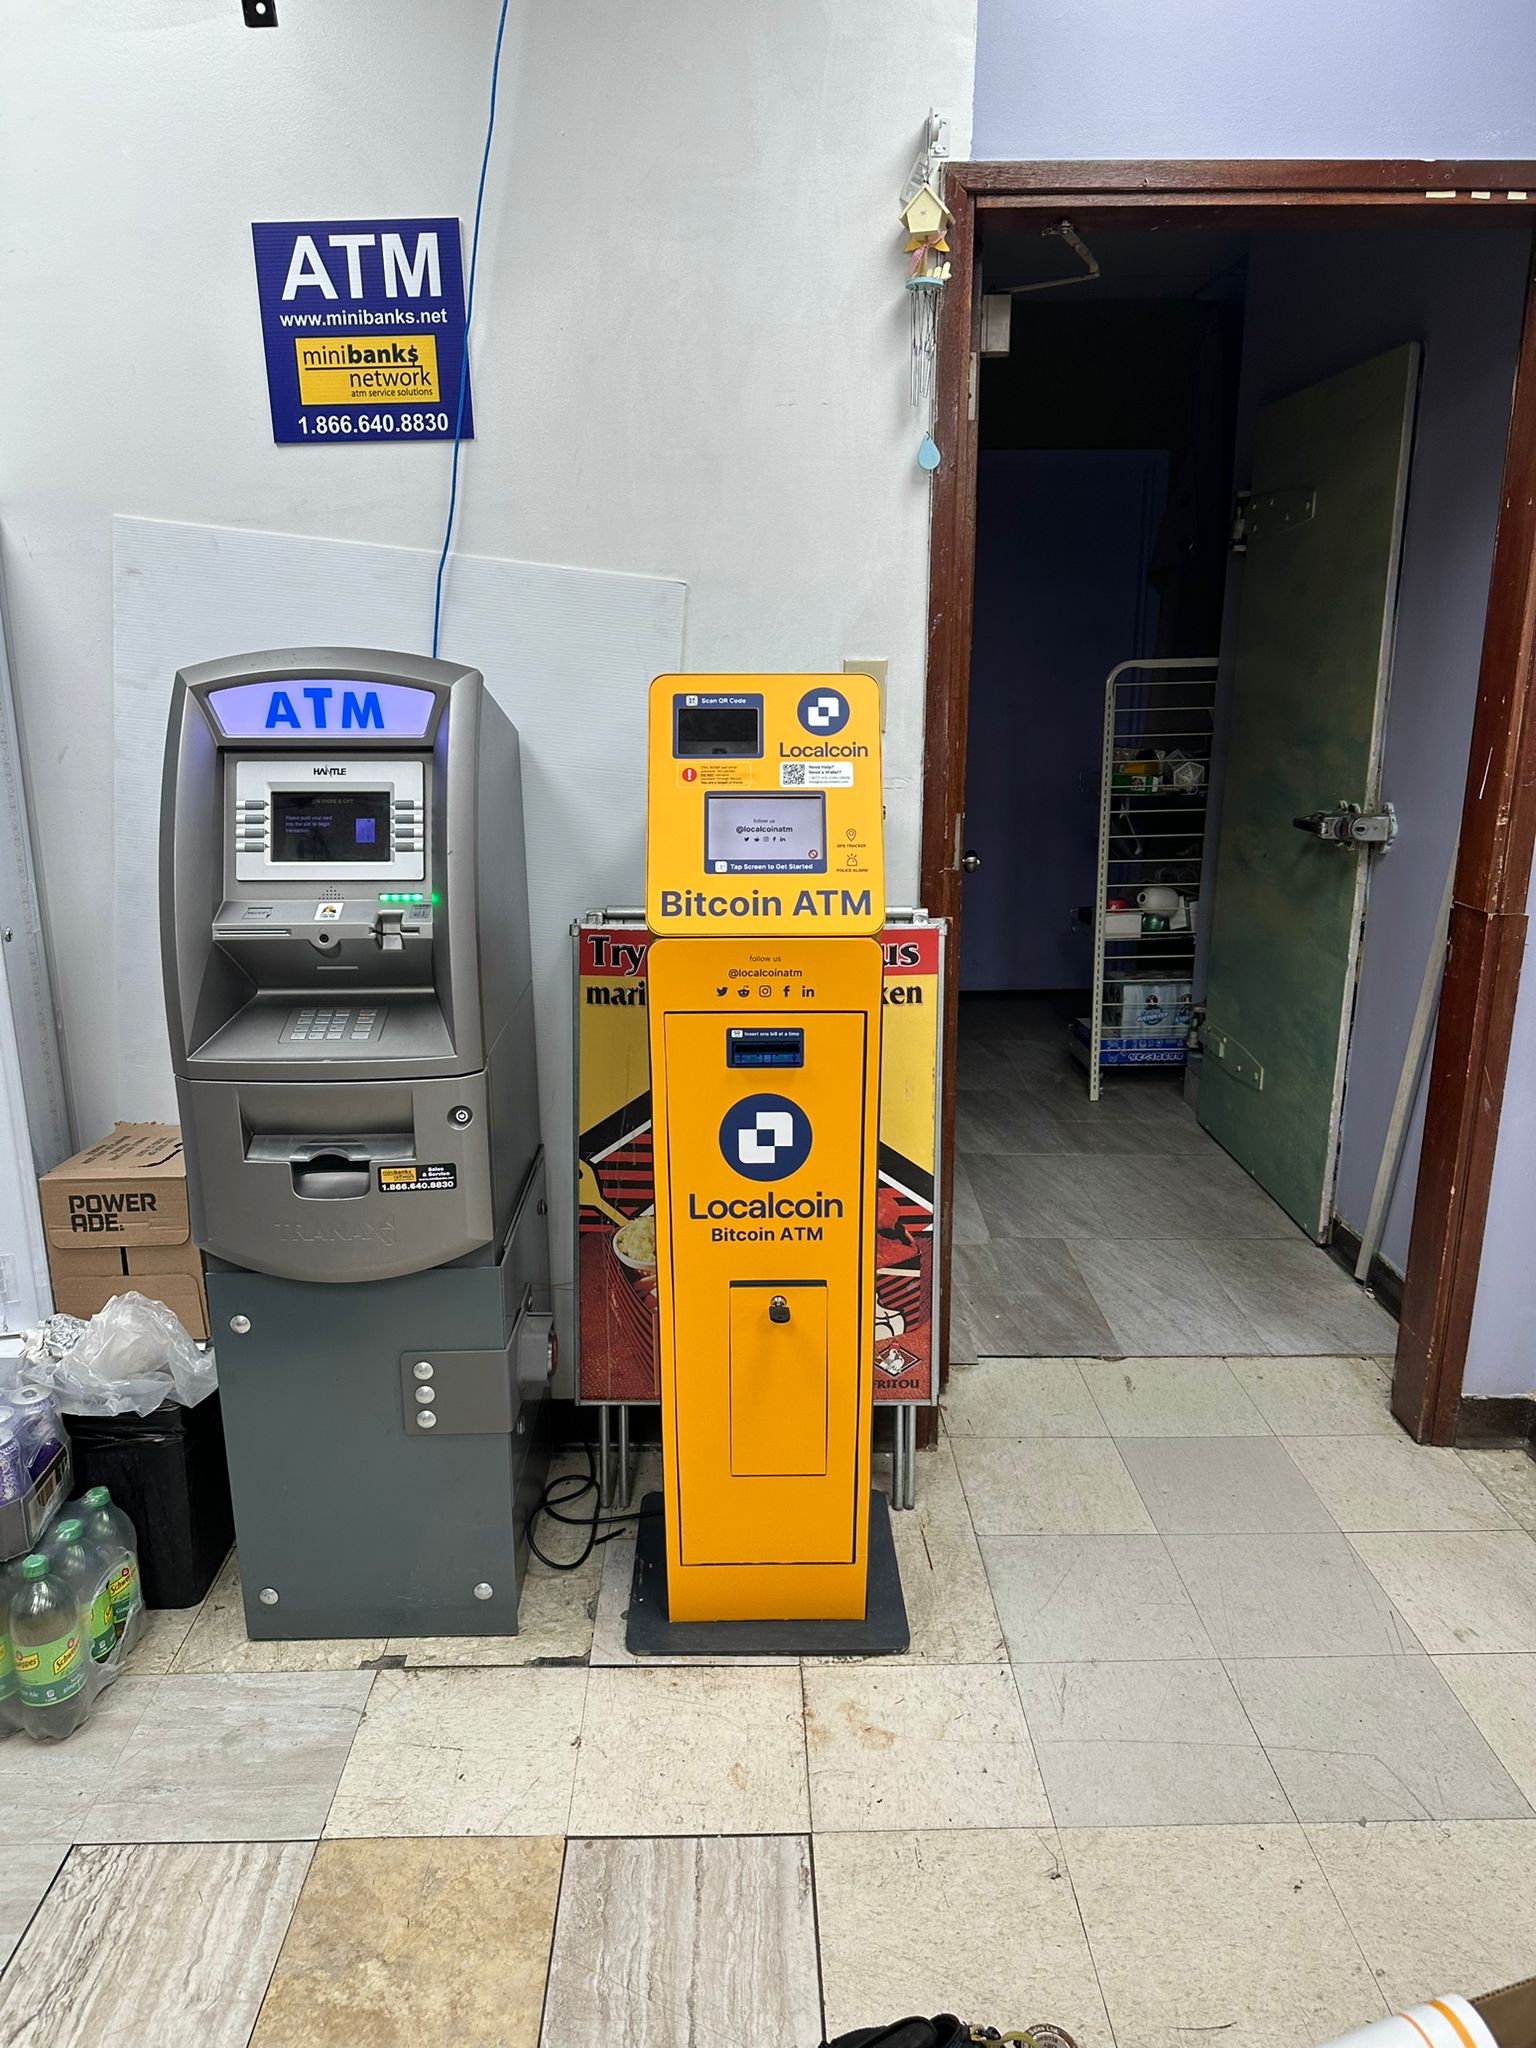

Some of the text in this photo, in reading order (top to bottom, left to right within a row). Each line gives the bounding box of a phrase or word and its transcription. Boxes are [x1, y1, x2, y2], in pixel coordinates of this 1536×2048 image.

[281, 232, 442, 300] ATM
[279, 308, 448, 327] www.minibanks.net
[349, 370, 432, 388] network
[351, 387, 433, 398] atm service solutions
[298, 412, 449, 435] 1.866.640.8830
[265, 687, 385, 729] ATM
[779, 741, 869, 758] Localcoin
[313, 765, 347, 777] HANTLE
[735, 825, 793, 834] @localcoinatm
[730, 863, 743, 872] Tap
[661, 889, 871, 917] Bitcoin ATM
[587, 934, 647, 976] Try
[880, 941, 921, 968] us
[728, 968, 803, 979] @localcoinatm
[381, 1180, 454, 1191] 1.866.640.8830
[68, 1193, 158, 1214] POWER
[688, 1191, 844, 1220] Localcoin
[711, 1226, 824, 1242] Bitcoin ATM
[874, 1379, 920, 1389] RITOU
